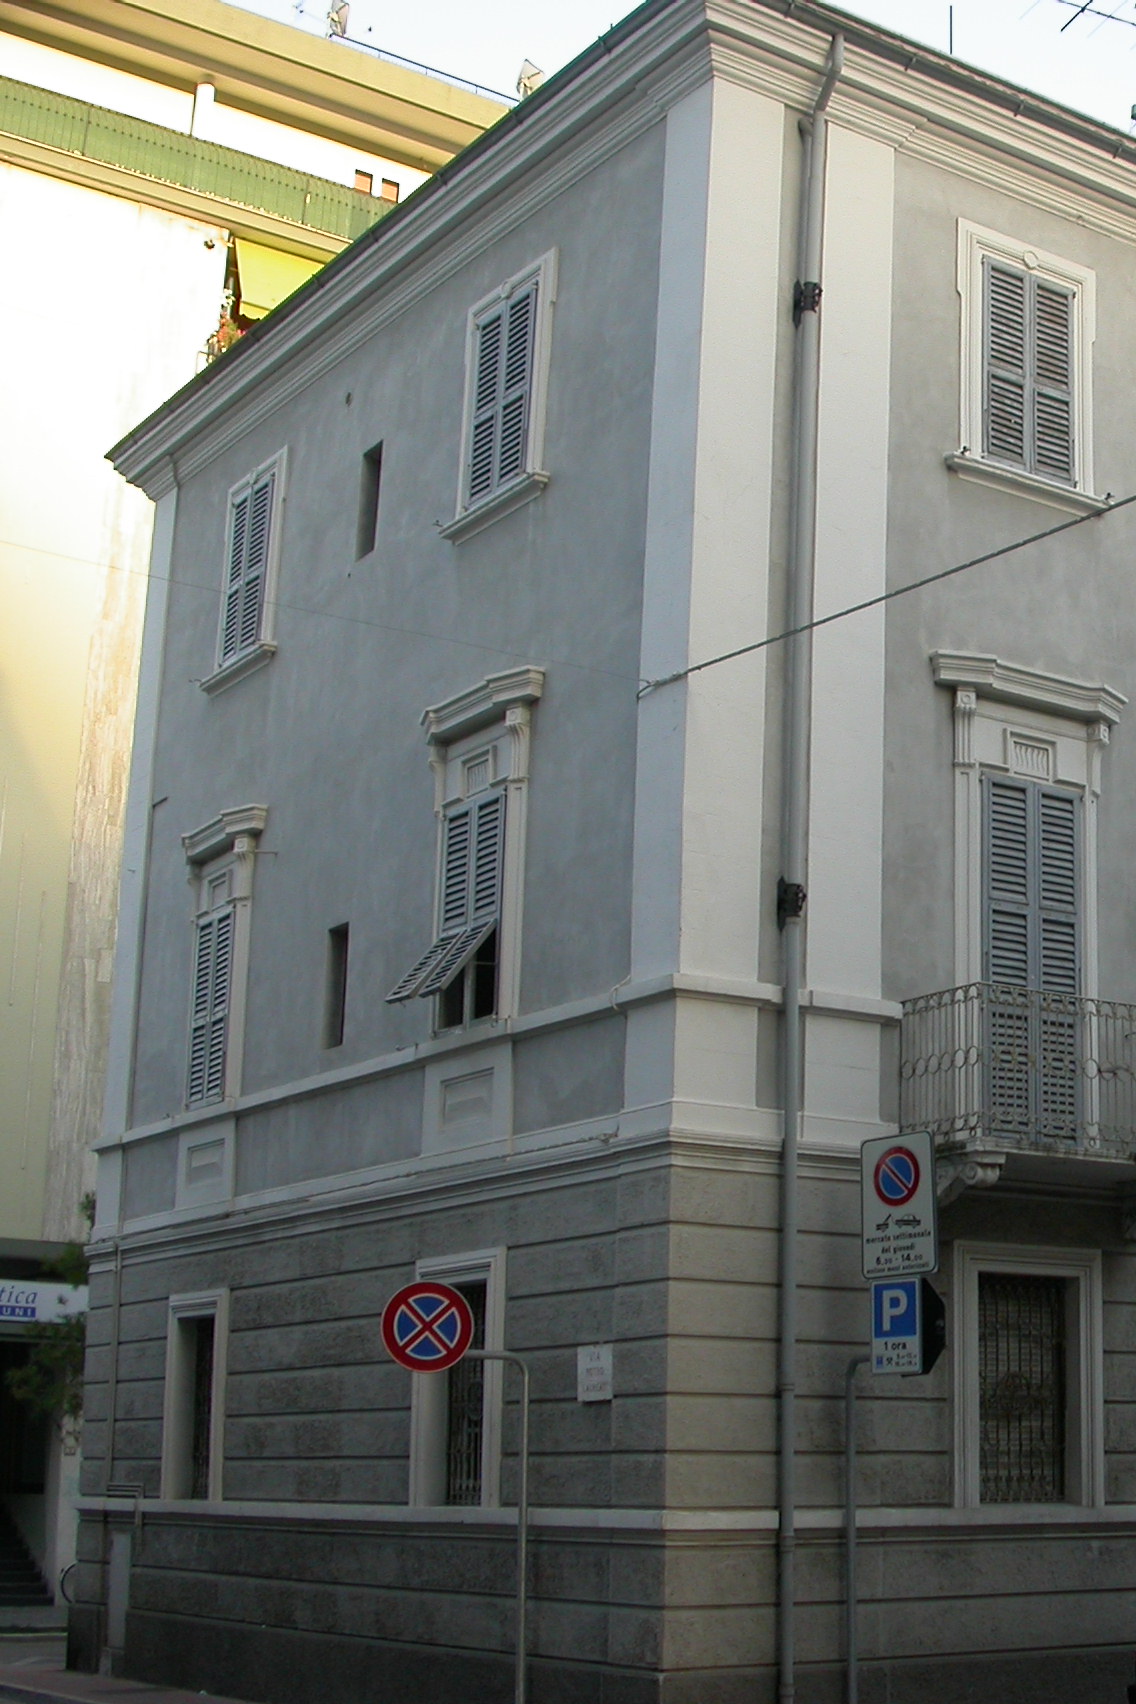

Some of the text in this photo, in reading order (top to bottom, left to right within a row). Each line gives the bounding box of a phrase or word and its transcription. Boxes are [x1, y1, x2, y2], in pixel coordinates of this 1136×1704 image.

[3, 1307, 32, 1316] UNI
[882, 1288, 908, 1332] P
[891, 1342, 907, 1351] ora
